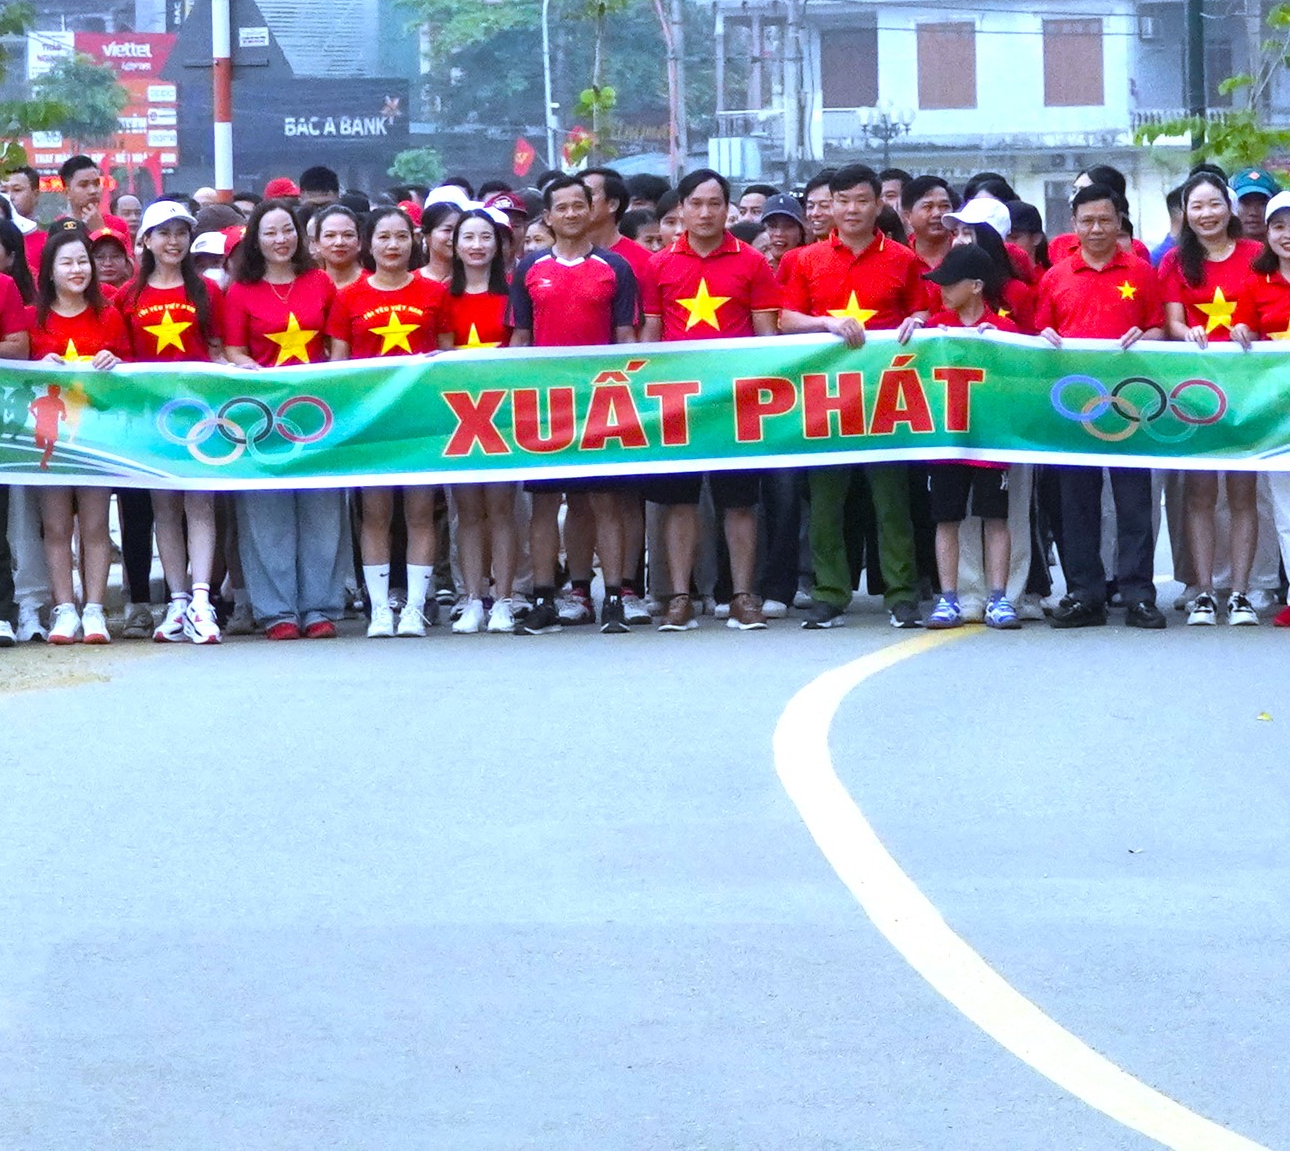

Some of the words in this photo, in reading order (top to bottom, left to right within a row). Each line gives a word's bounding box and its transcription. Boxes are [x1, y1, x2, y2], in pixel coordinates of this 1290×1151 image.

[101, 41, 153, 58] viettel
[284, 116, 320, 136] BAC
[323, 116, 337, 136] A
[339, 115, 387, 136] BANK
[441, 359, 701, 457] XUẤT
[733, 354, 986, 443] PHÁT
